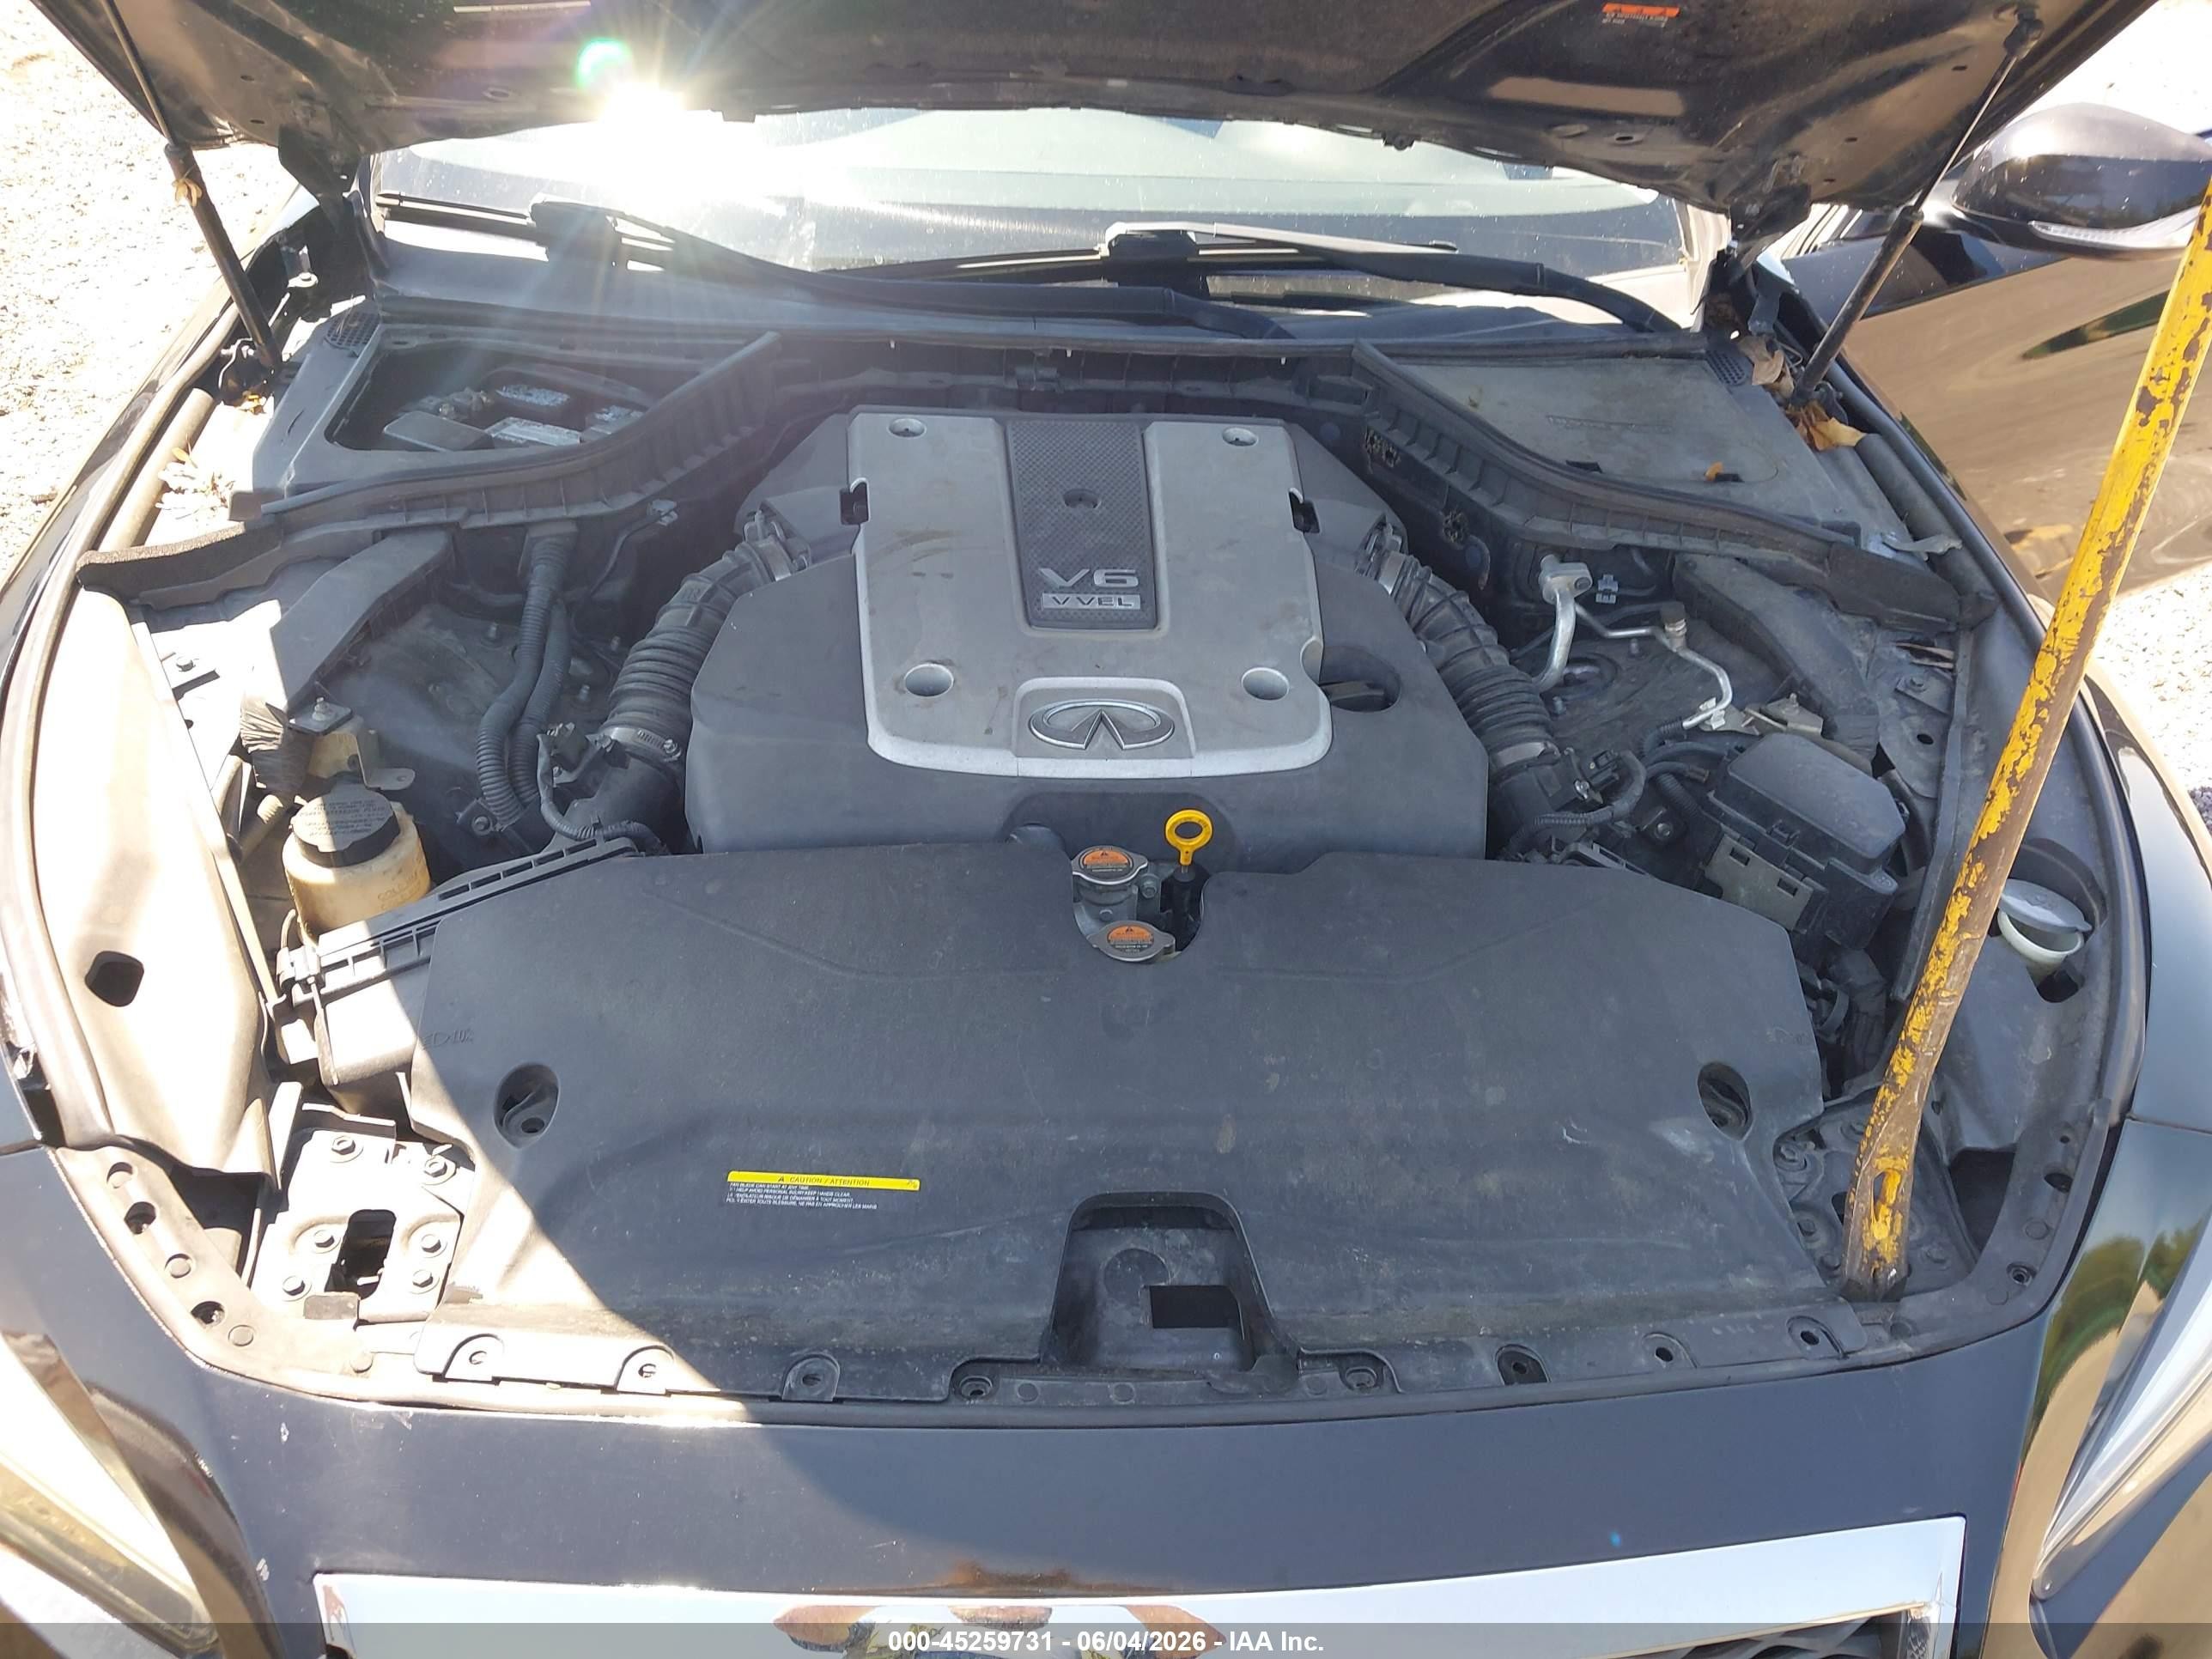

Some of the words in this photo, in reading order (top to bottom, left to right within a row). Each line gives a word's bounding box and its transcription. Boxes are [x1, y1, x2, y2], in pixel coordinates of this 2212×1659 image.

[1039, 568, 1139, 588] V6
[1052, 596, 1133, 606] VVEL
[830, 1178, 870, 1187] ATTENTION
